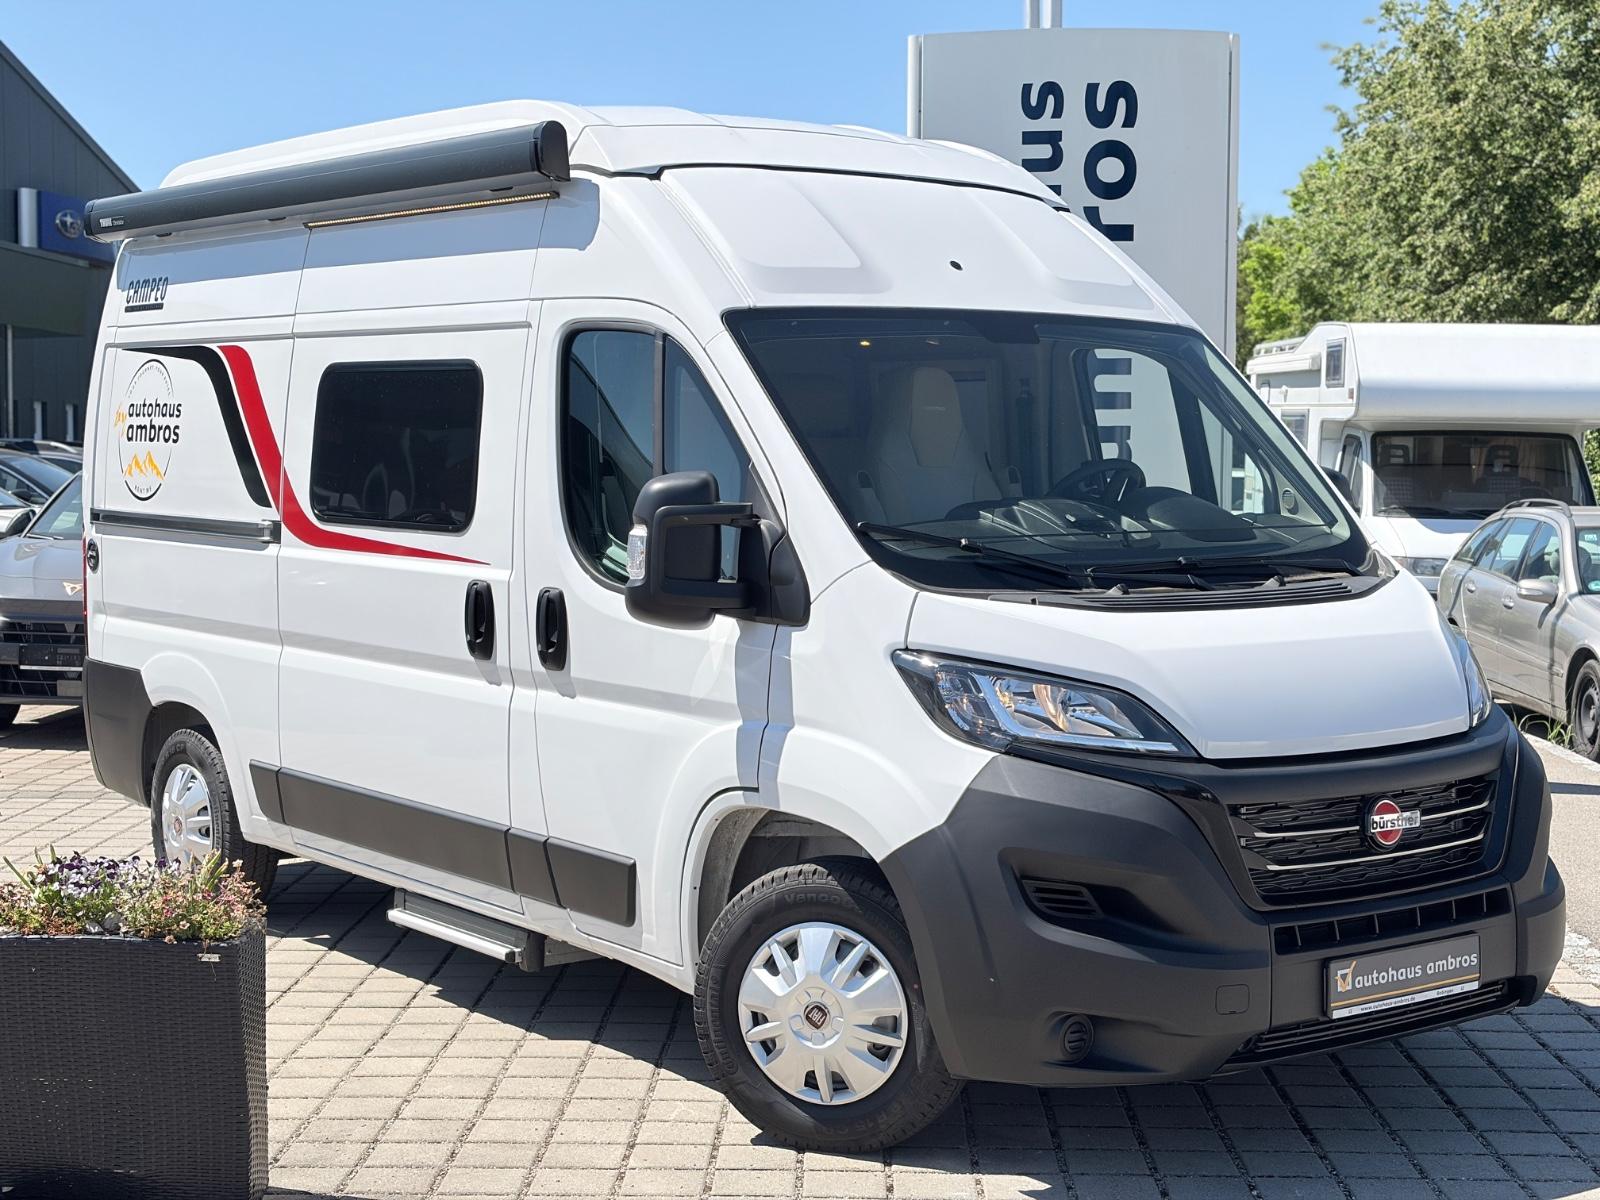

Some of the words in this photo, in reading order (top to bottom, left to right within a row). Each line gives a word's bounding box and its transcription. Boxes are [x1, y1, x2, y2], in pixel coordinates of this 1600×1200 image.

[1021, 80, 1064, 192] us
[126, 276, 168, 304] CAMPEO
[128, 398, 182, 418] autohaus
[126, 418, 180, 443] ambros
[1355, 965, 1422, 988] autohaus
[1426, 953, 1478, 974] ambros
